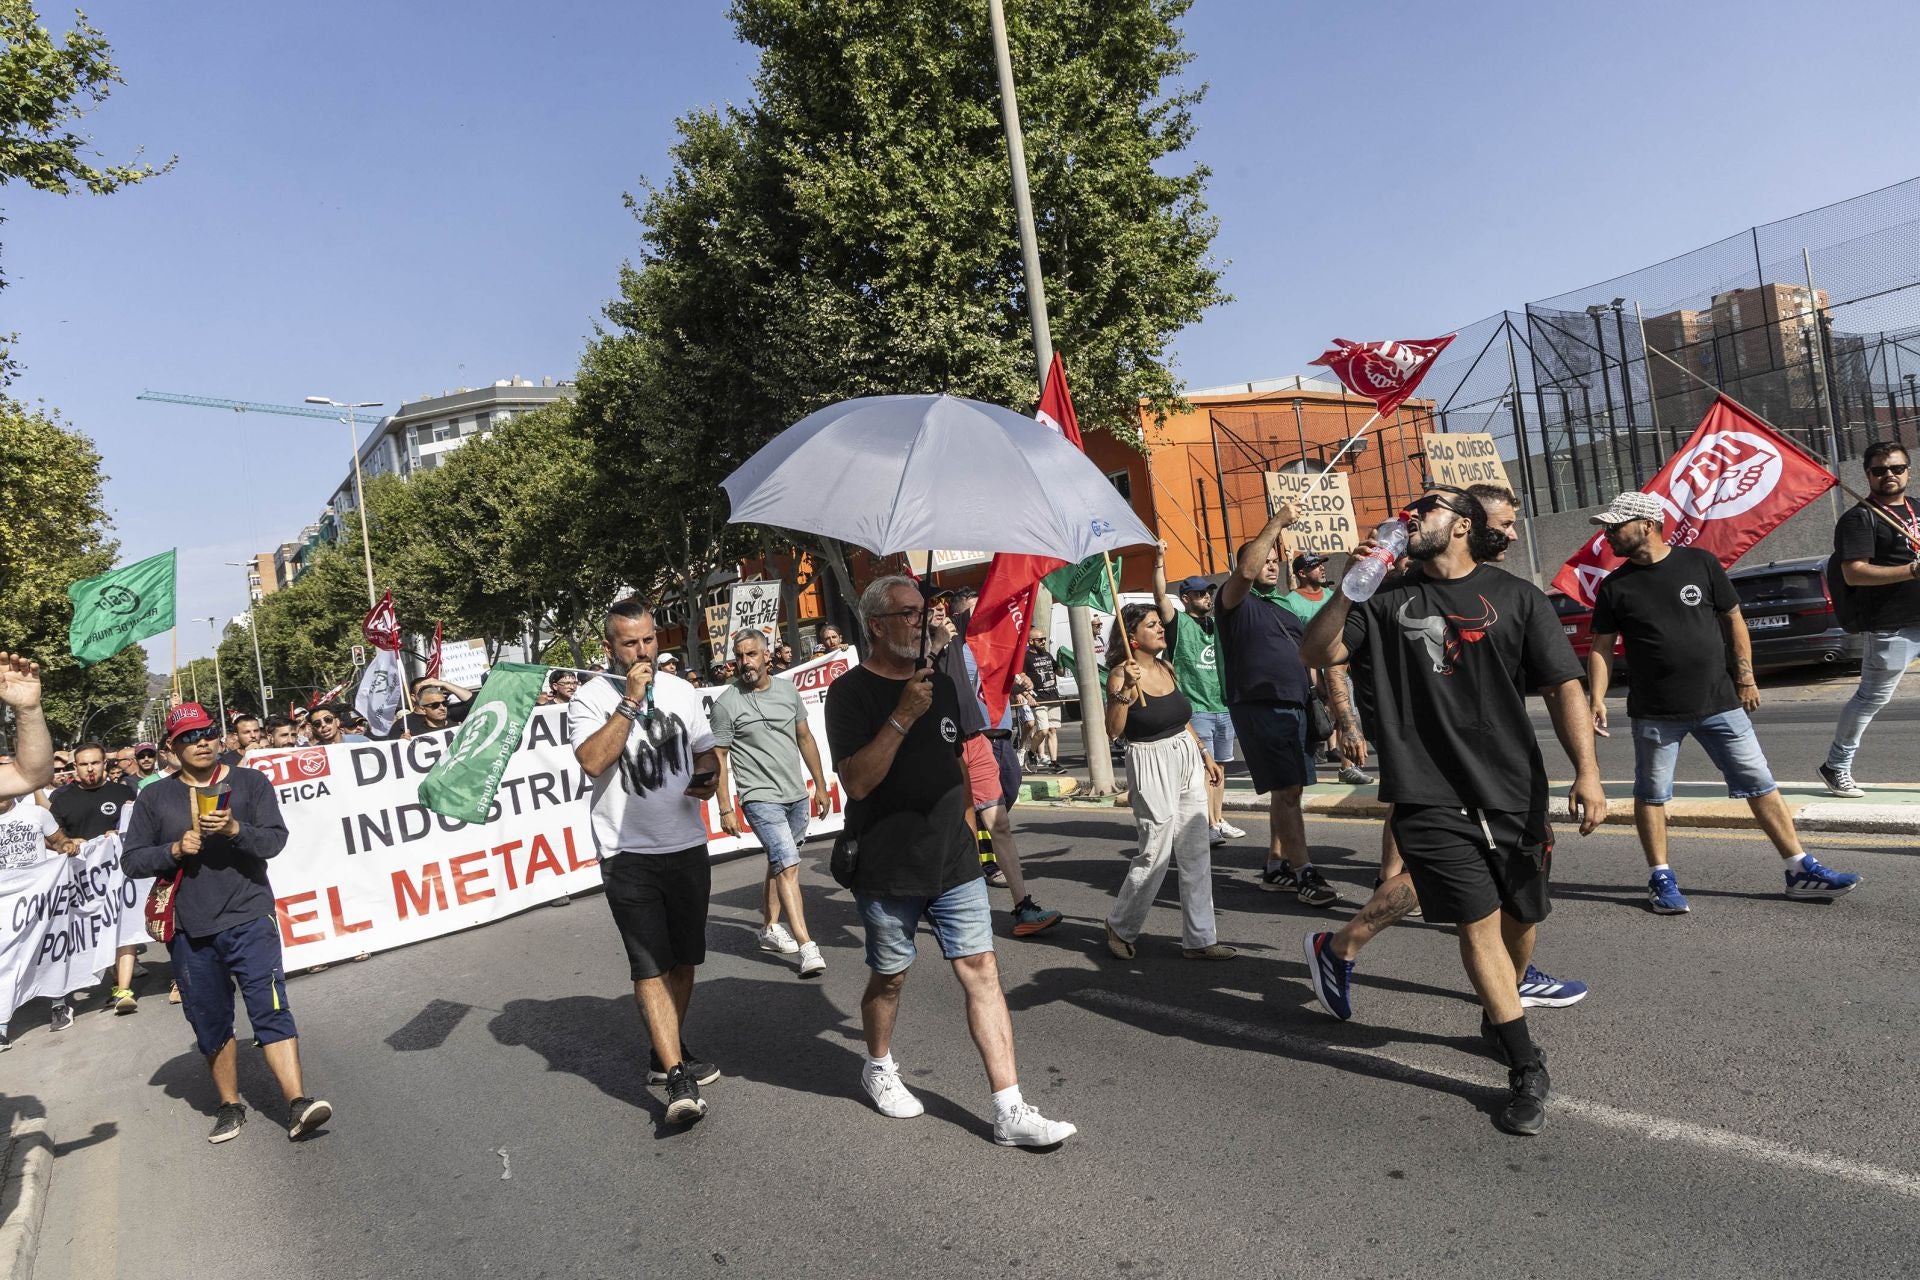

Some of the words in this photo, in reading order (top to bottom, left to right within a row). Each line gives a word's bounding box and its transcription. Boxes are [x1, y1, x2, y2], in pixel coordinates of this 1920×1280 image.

[1458, 462, 1483, 483] PLUS
[1482, 461, 1501, 480] DE
[1278, 474, 1311, 493] PLUS
[1320, 475, 1339, 491] DE
[1315, 520, 1324, 532] A
[1329, 517, 1350, 532] LA
[1296, 533, 1344, 551] LUCHA
[736, 601, 756, 616] SOY
[761, 598, 779, 612] DEL
[740, 612, 776, 627] METAL
[793, 665, 827, 690] UGT
[246, 755, 293, 783] GT
[280, 781, 331, 804] FICA
[341, 768, 595, 855] INDTRIA
[275, 886, 373, 947] EL
[391, 826, 600, 922] METAL
